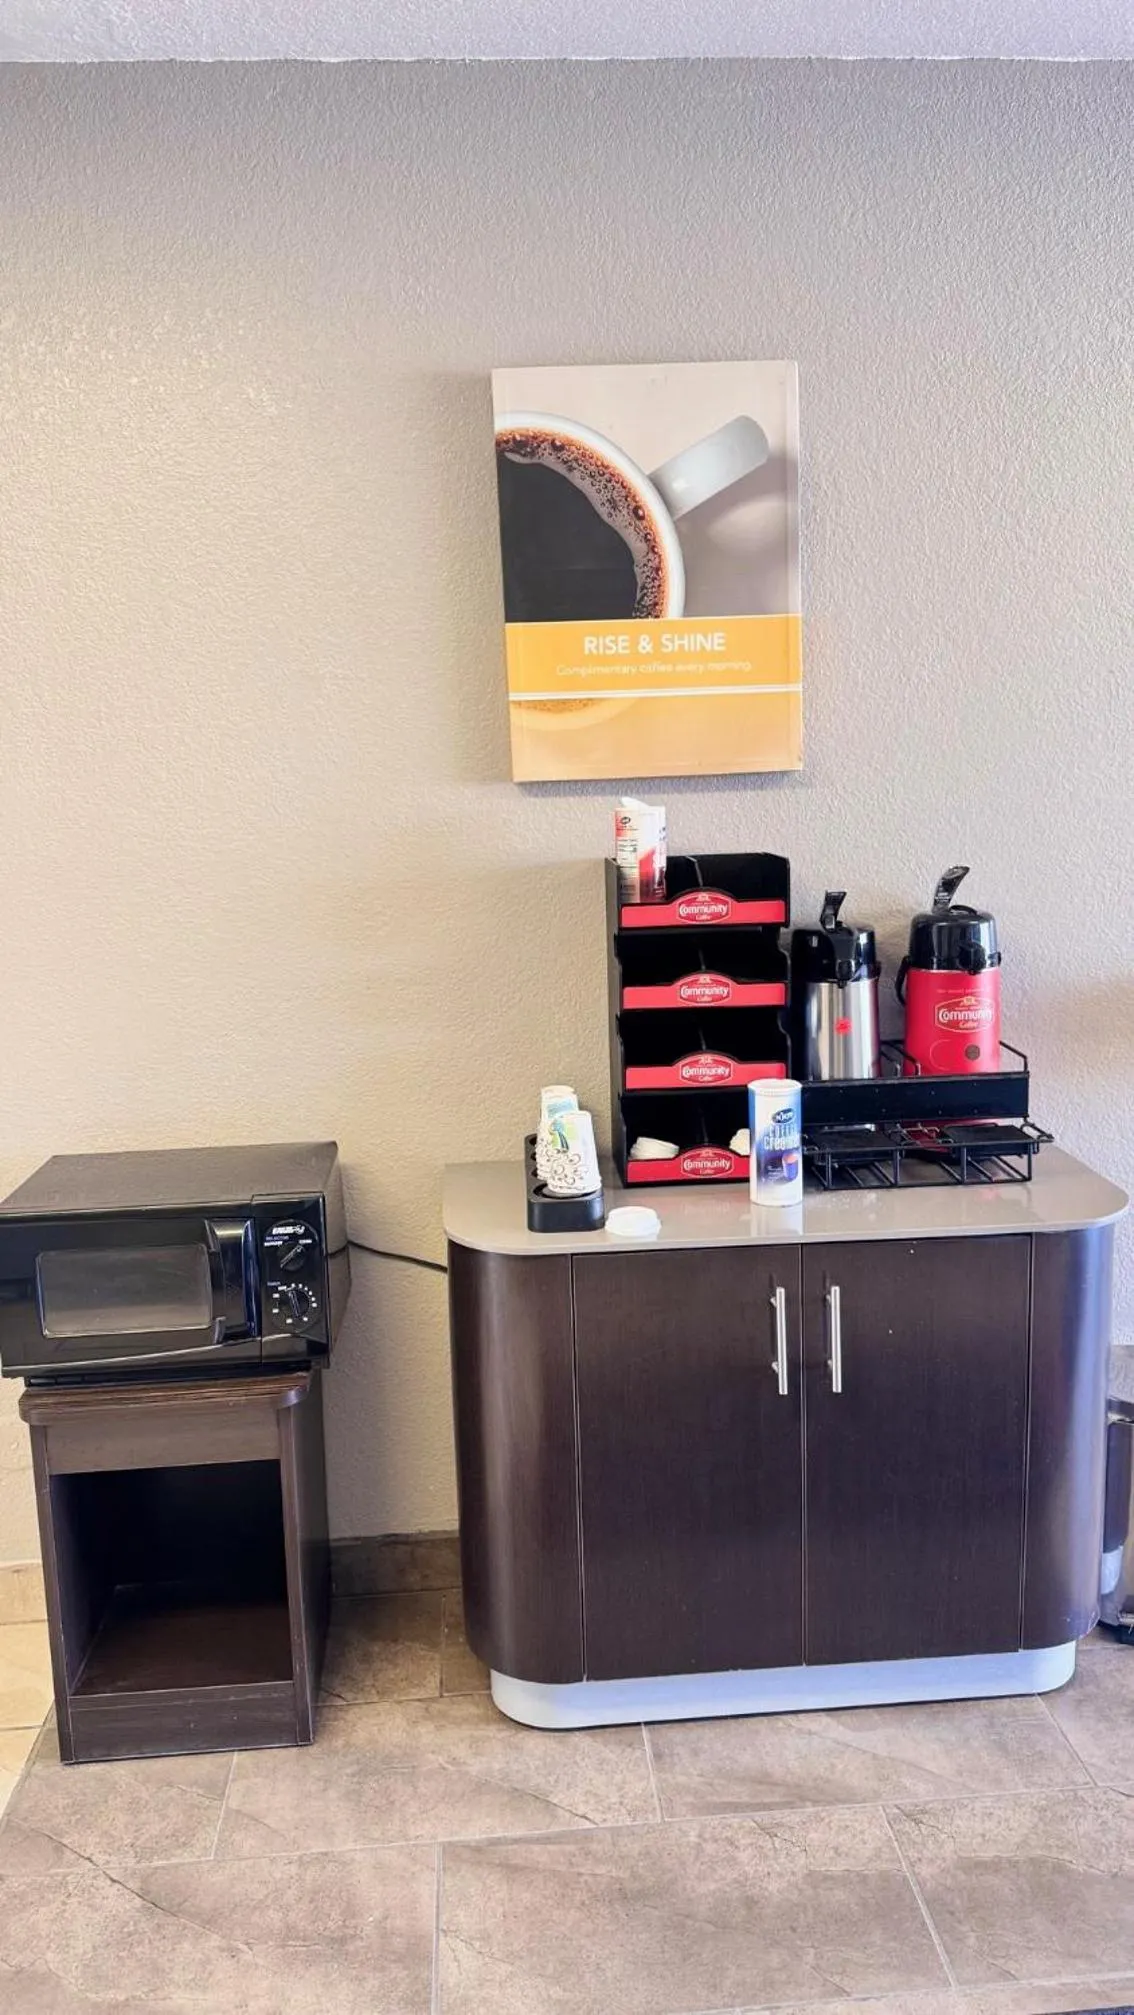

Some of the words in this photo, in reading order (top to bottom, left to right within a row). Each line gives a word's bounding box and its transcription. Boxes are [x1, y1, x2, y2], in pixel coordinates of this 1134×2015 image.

[584, 635, 630, 655] RISE
[638, 634, 653, 654] &
[661, 632, 726, 652] SHINE
[556, 664, 638, 677] Complimentary
[640, 662, 673, 673] coffee
[675, 663, 706, 674] every
[679, 903, 728, 916] Community
[681, 985, 728, 998] Community
[682, 1065, 730, 1078] Community
[683, 1158, 730, 1171] Community
